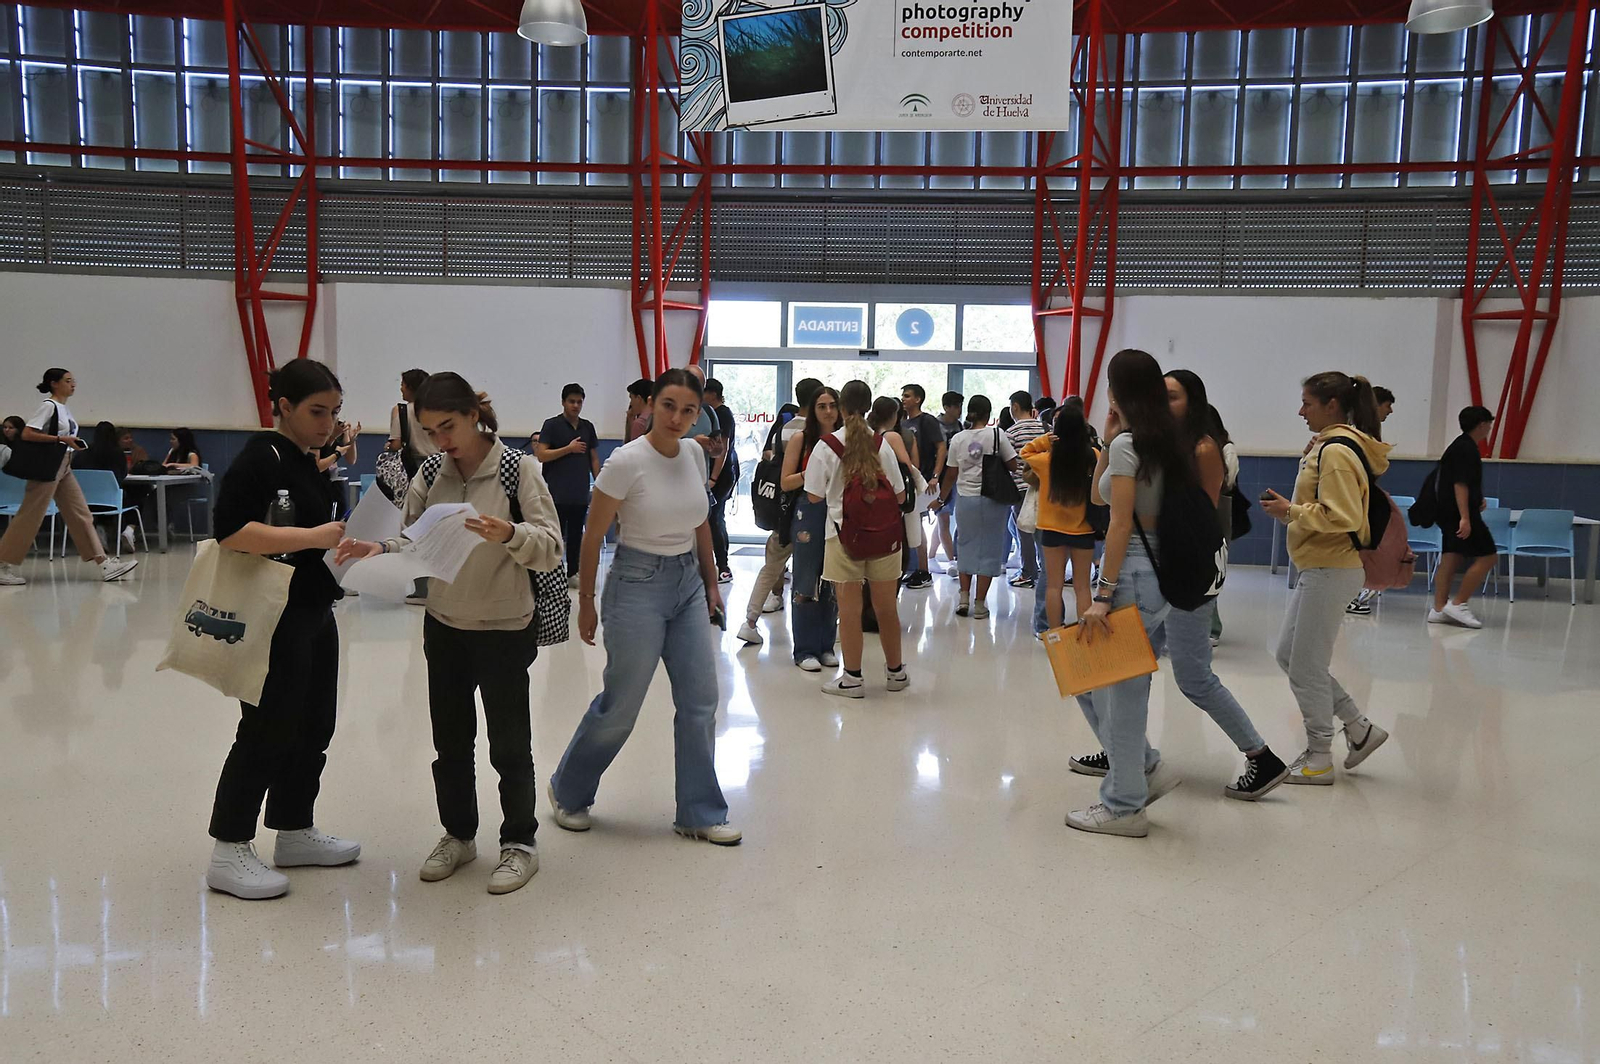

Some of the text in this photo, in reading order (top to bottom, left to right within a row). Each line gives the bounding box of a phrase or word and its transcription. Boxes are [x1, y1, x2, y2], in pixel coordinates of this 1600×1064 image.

[902, 2, 1024, 23] photography
[901, 22, 1013, 42] competition
[901, 49, 983, 59] contemporarte.net
[979, 93, 1033, 105] Universidad
[983, 105, 995, 117] de
[996, 106, 1029, 118] Huelva
[757, 478, 776, 500] VAN
